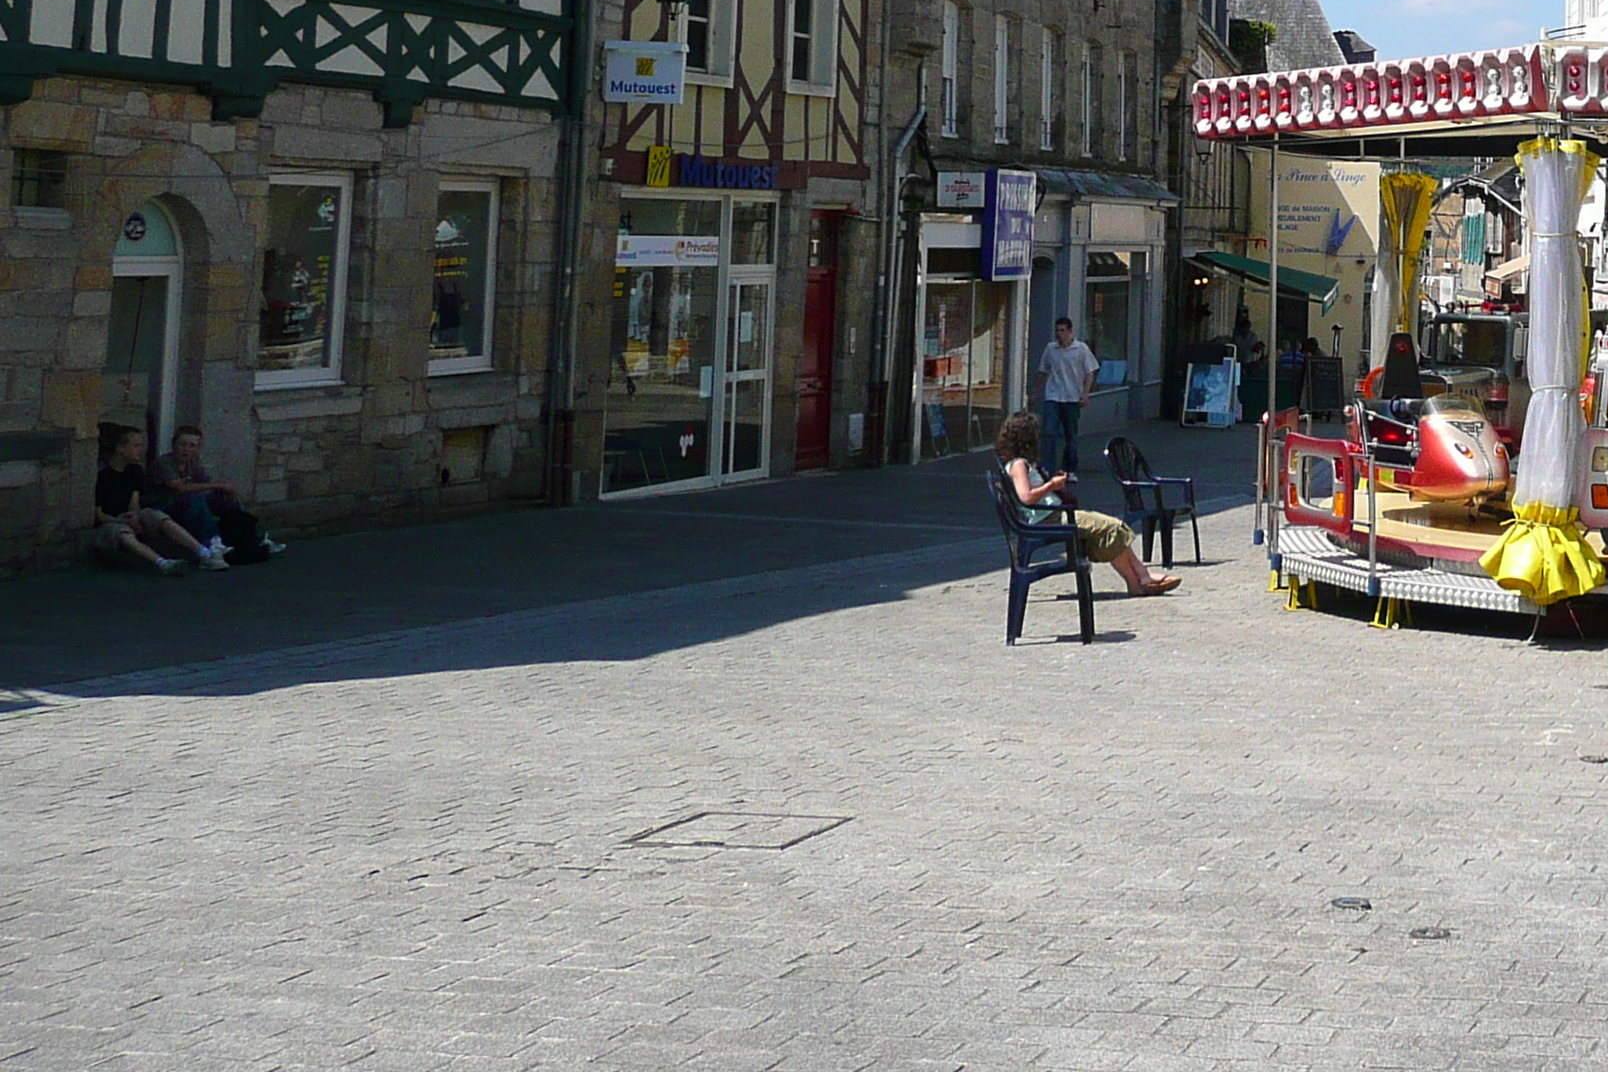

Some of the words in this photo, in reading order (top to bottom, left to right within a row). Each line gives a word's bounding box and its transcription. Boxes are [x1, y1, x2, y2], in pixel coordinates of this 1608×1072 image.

[610, 80, 677, 95] Mutouest
[680, 152, 781, 189] Mutouest
[1285, 168, 1319, 182] Pince
[1333, 168, 1367, 187] Linge
